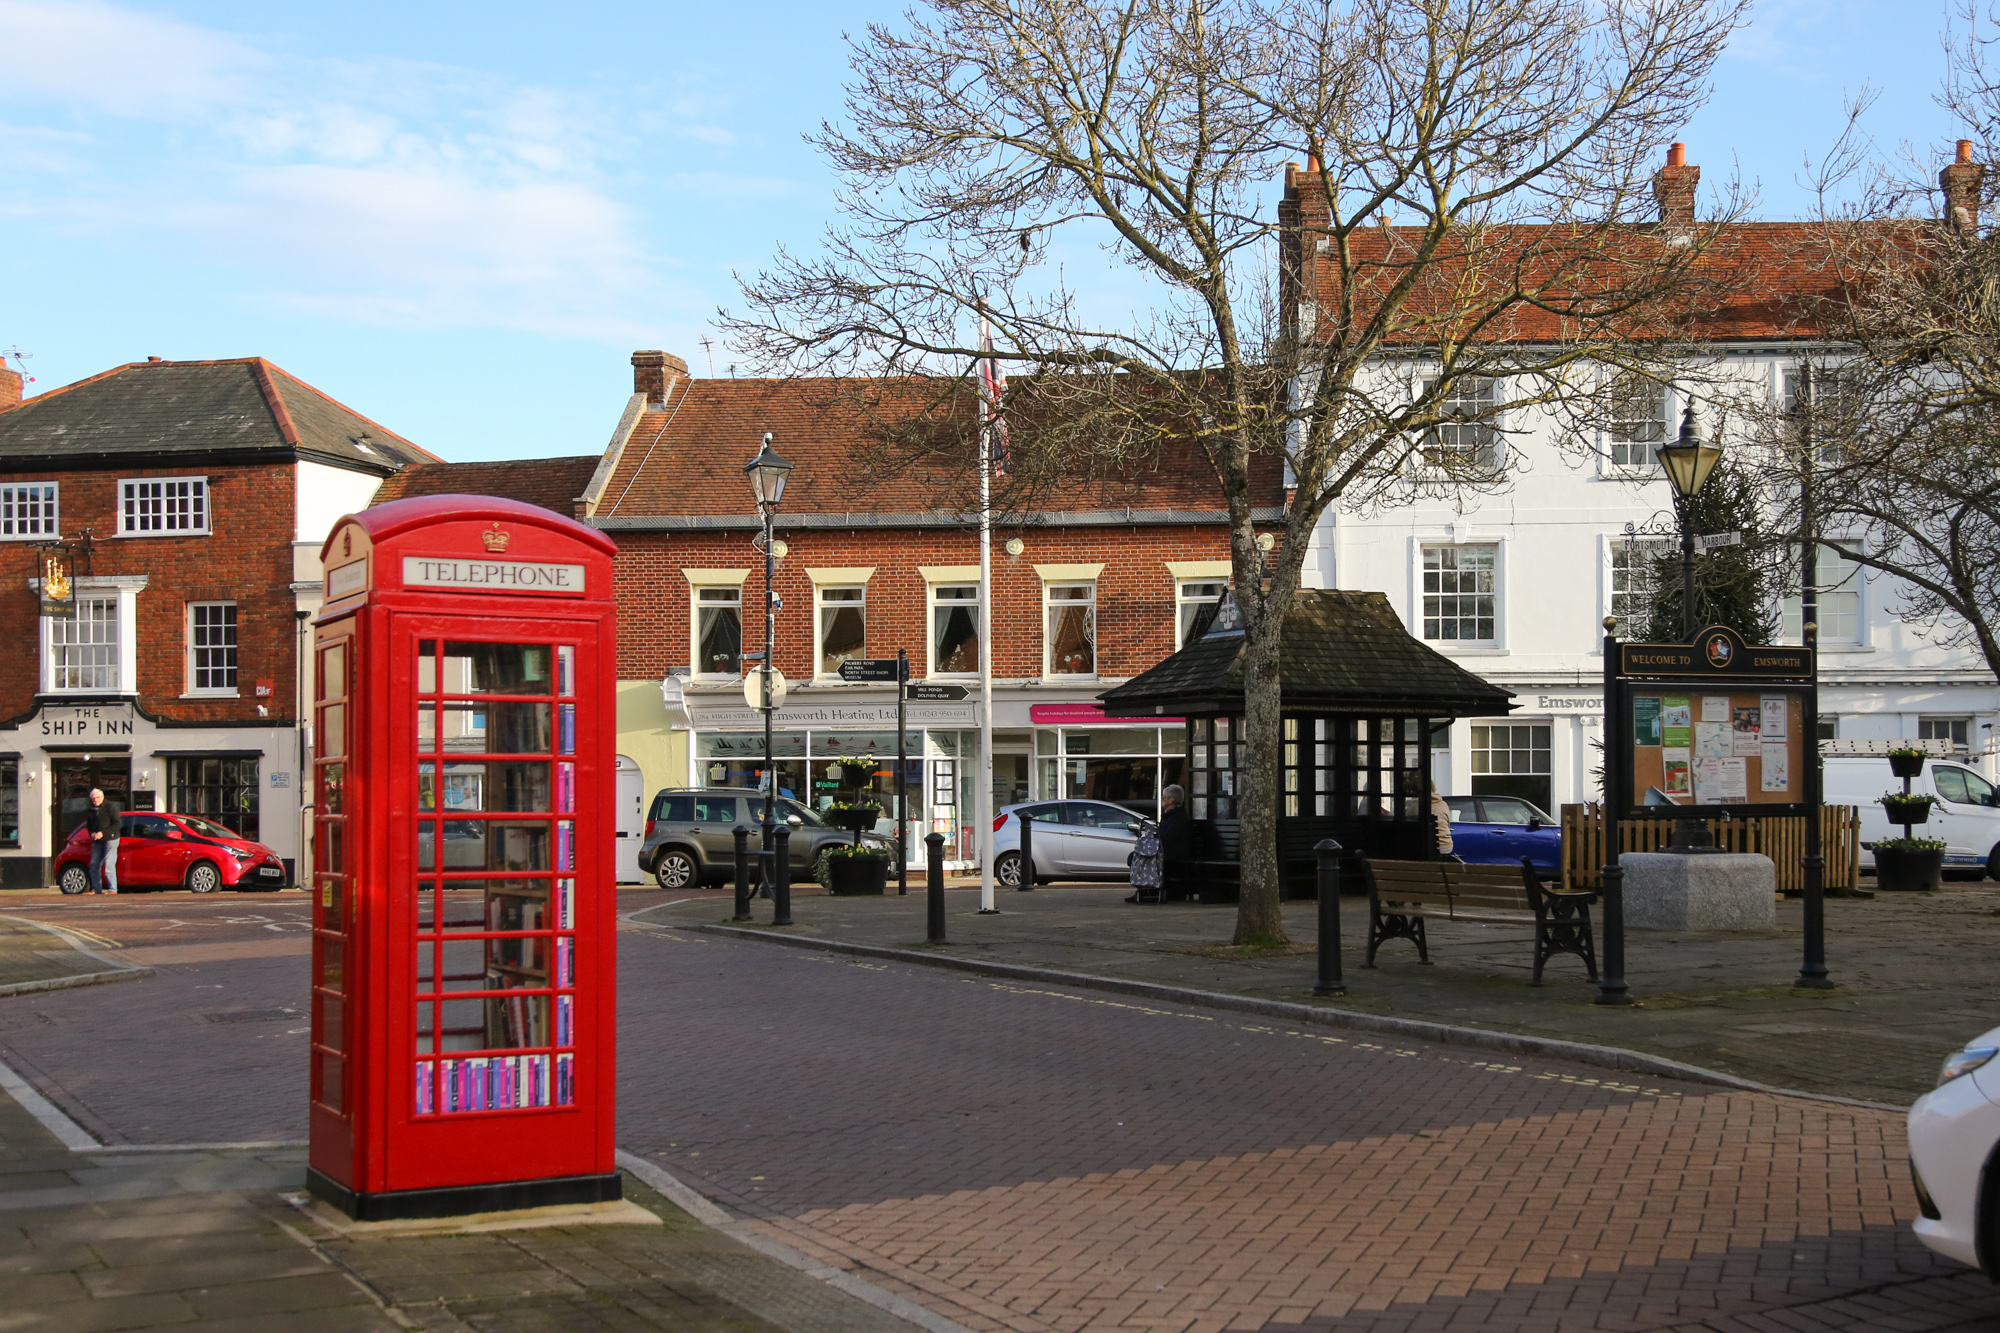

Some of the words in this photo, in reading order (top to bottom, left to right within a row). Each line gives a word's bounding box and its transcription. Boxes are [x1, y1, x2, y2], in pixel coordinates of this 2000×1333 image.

[1624, 539, 1677, 551] PORTSMOUTH
[1701, 532, 1731, 547] HARBOUR
[418, 561, 570, 587] TELEPHONE
[1631, 654, 1677, 665] WELCOME
[1679, 655, 1691, 665] TO
[1753, 657, 1800, 667] EMSWORTH
[1537, 695, 1604, 708] Emswor
[75, 708, 100, 718] THE
[832, 709, 876, 721] Heating
[879, 708, 899, 720] Ltd
[919, 710, 938, 718] 01243
[939, 710, 952, 718] 950
[953, 710, 967, 718] 694
[41, 720, 87, 735] SHIP
[98, 720, 133, 735] INN
